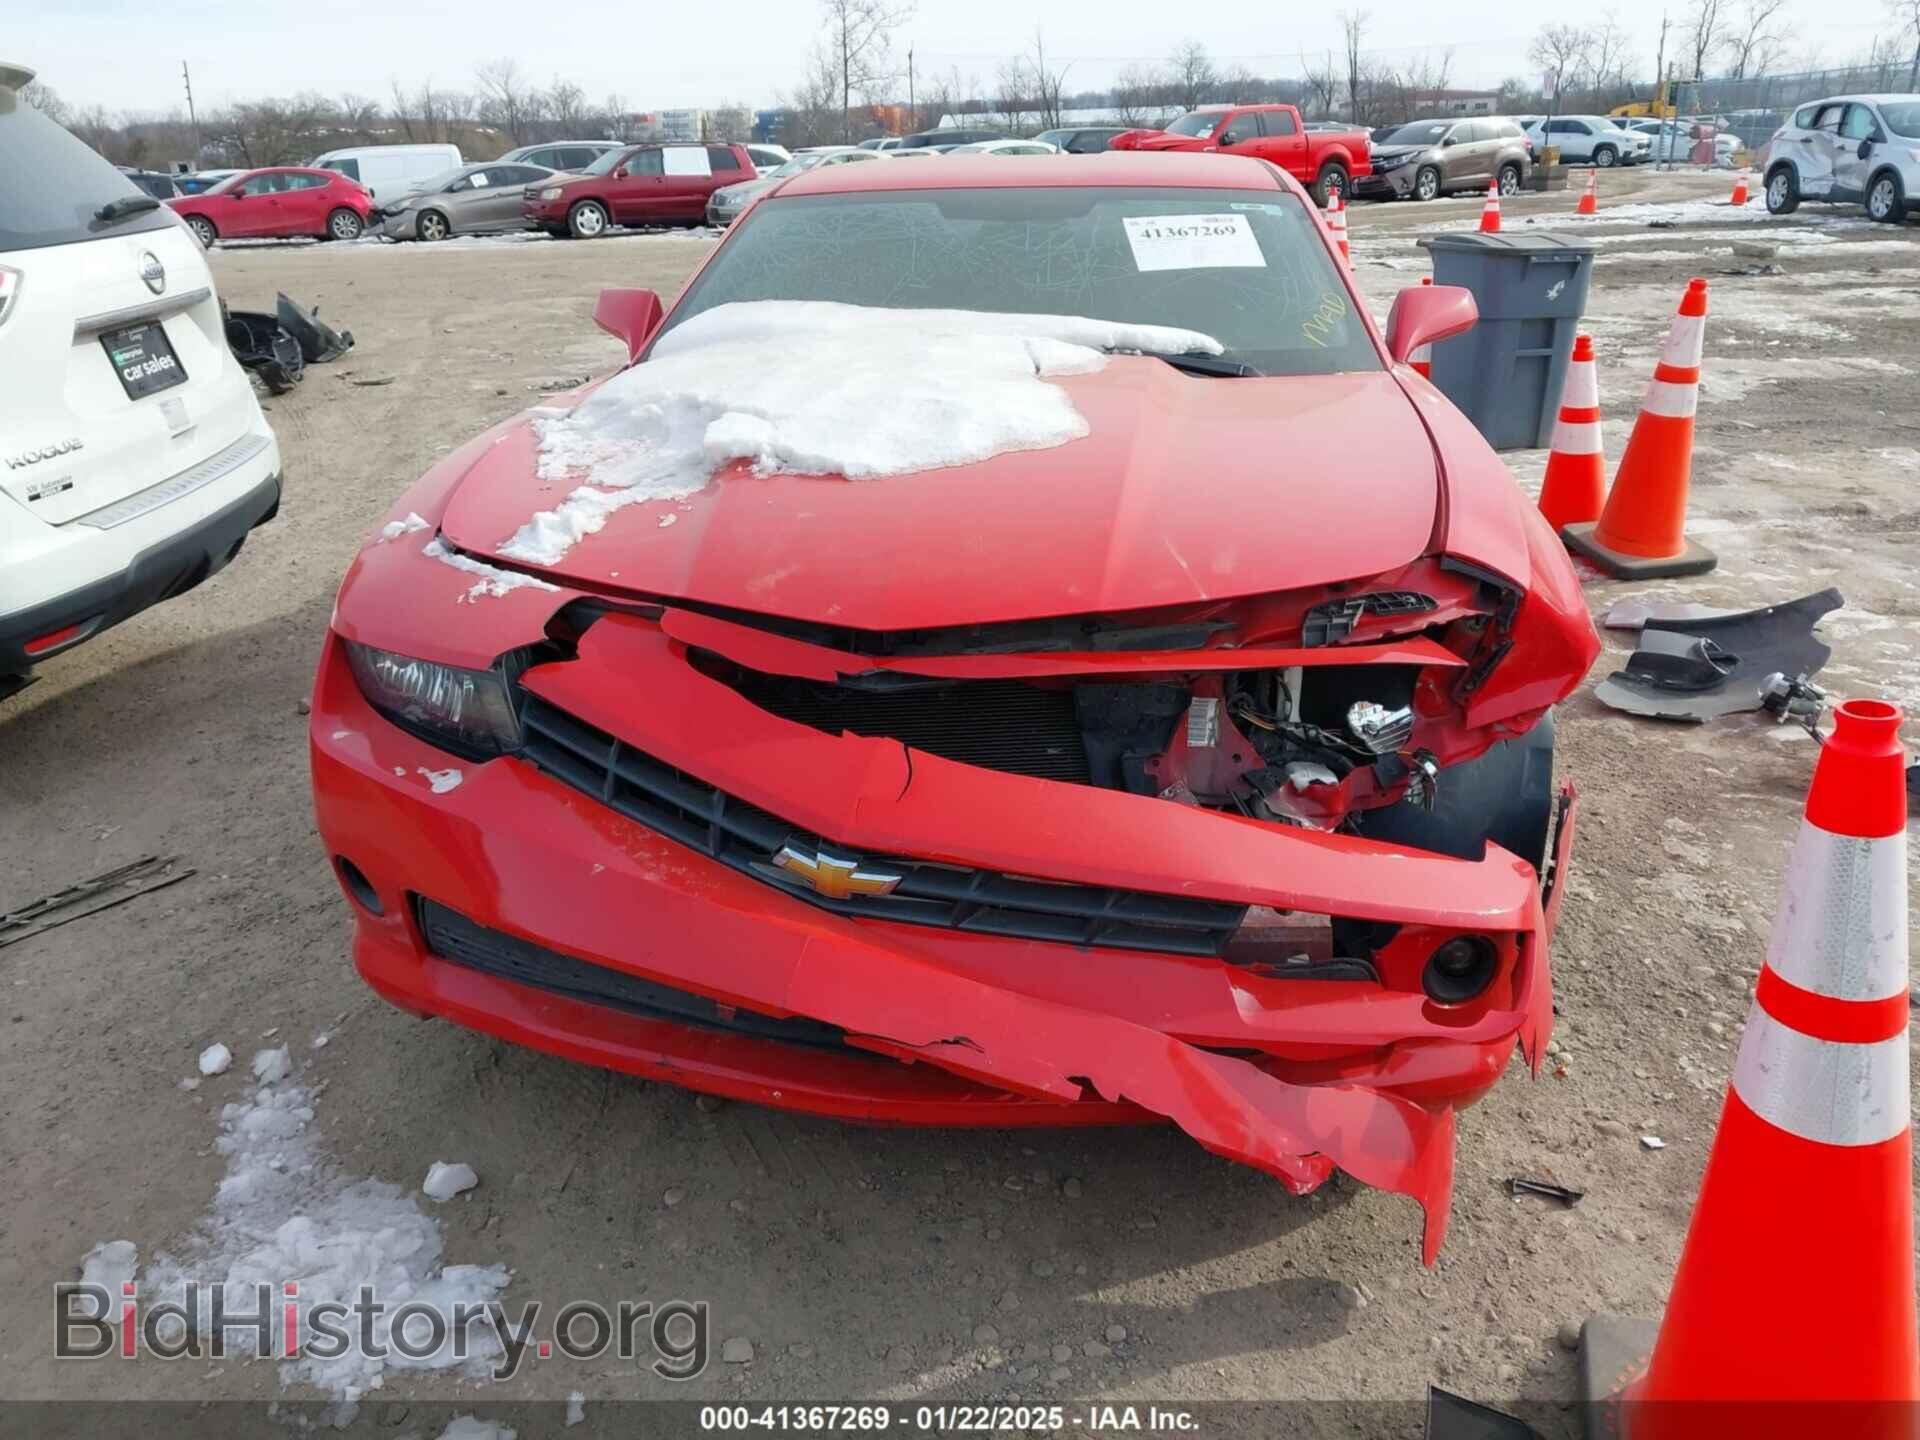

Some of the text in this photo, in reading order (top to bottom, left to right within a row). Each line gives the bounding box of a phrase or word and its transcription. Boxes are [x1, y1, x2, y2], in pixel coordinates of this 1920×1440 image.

[1140, 225, 1237, 239] 41367269
[123, 364, 145, 381] car
[142, 353, 176, 375] sales
